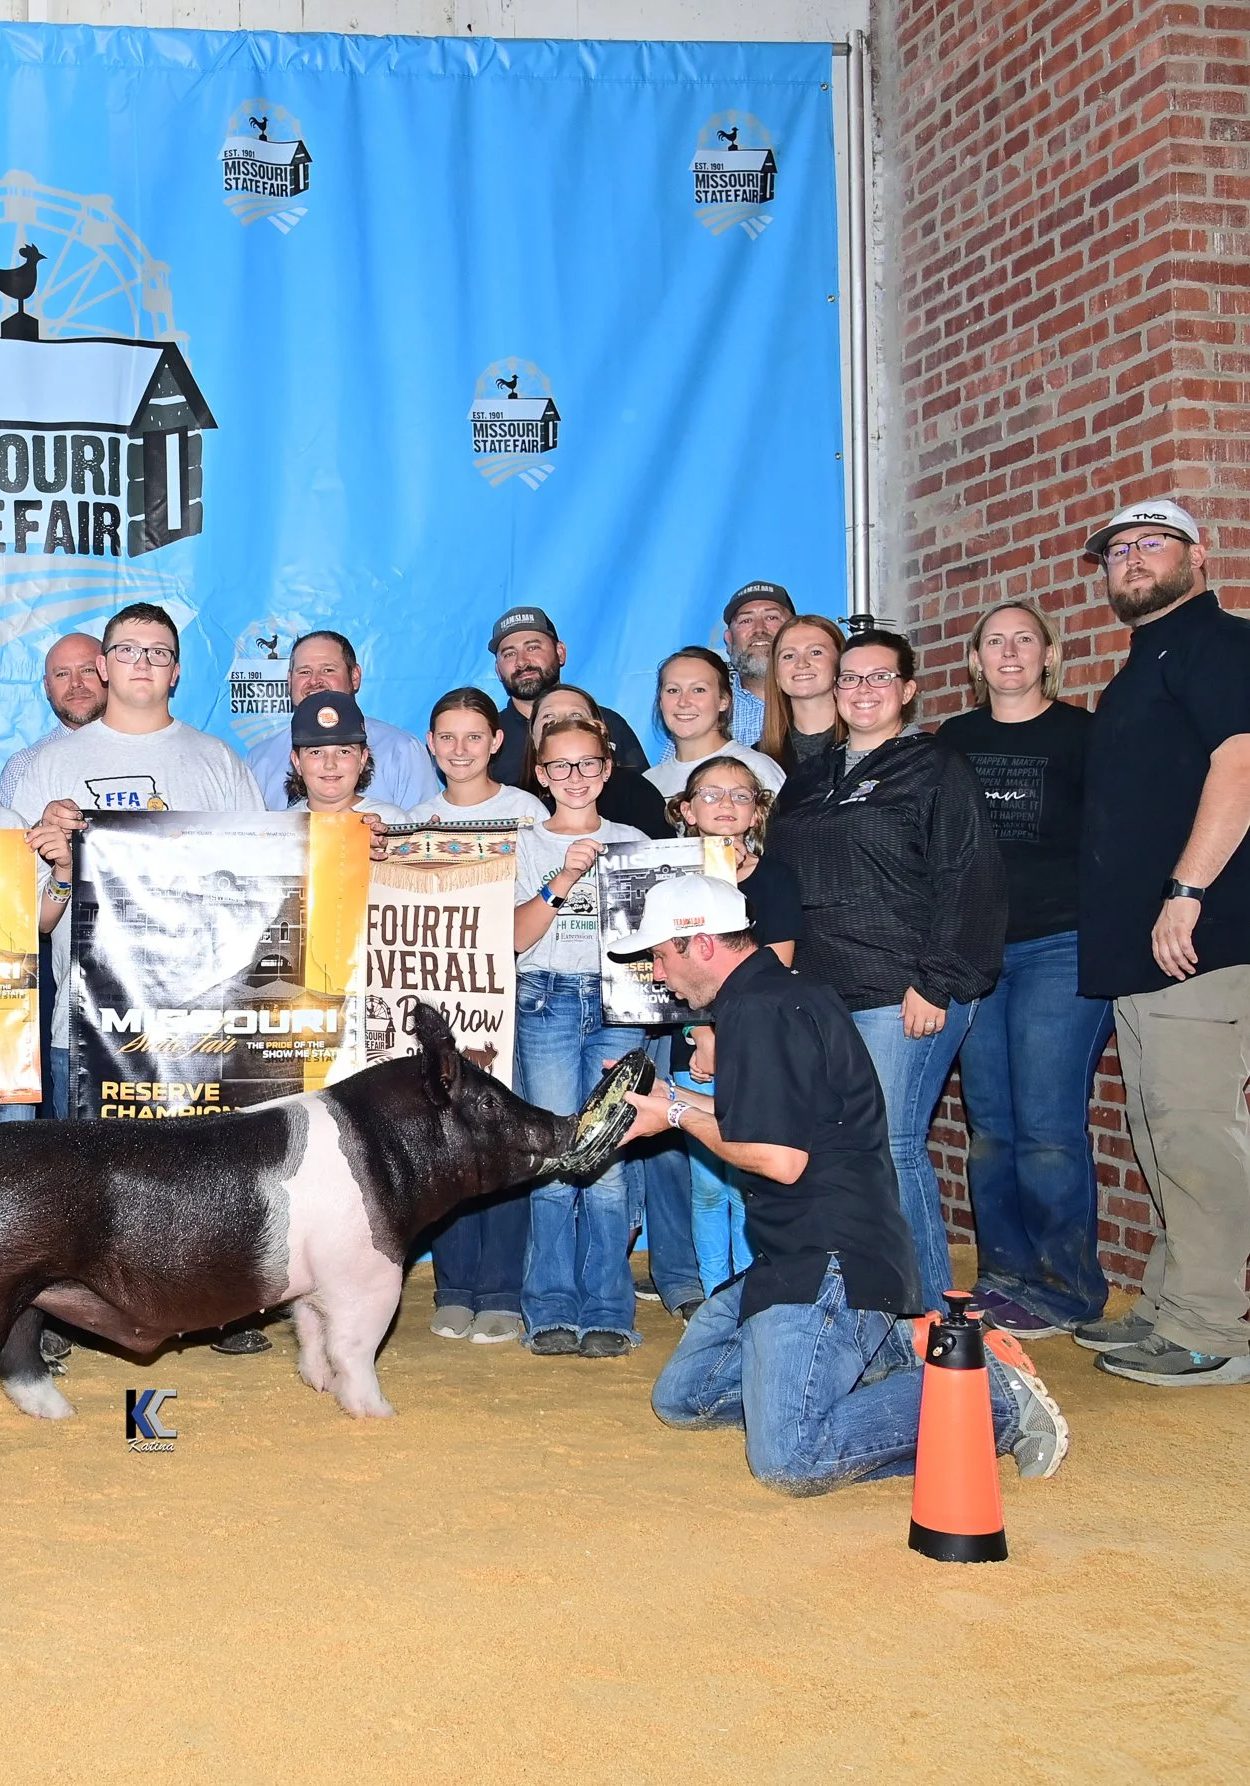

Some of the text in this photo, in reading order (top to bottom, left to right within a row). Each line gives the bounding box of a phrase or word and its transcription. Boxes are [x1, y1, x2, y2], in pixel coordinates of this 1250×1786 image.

[224, 149, 255, 158] EST. 1901
[224, 160, 288, 182] MISSOURI
[694, 162, 709, 170] EST.
[224, 177, 289, 197] STATE FAIR
[695, 173, 758, 189] MISSOURI
[695, 189, 759, 203] STATE FAIR
[473, 422, 538, 438] MISSOURI
[474, 439, 539, 453] STATE FAIR
[14, 500, 122, 557] FAIR
[231, 700, 269, 714] STATE
[106, 792, 141, 807] FFA
[367, 904, 481, 949] FOURTH
[557, 920, 597, 930] -H EXHIBI
[622, 962, 654, 972] ESER
[396, 994, 504, 1036] Brrow
[366, 1032, 385, 1042] SOURI
[246, 1042, 265, 1050] THE
[294, 1041, 307, 1049] OF
[308, 1041, 325, 1049] THE
[372, 1040, 385, 1050] FAIR
[262, 1050, 341, 1059] SHOW ME STAT
[102, 1082, 220, 1101] RESERVE
